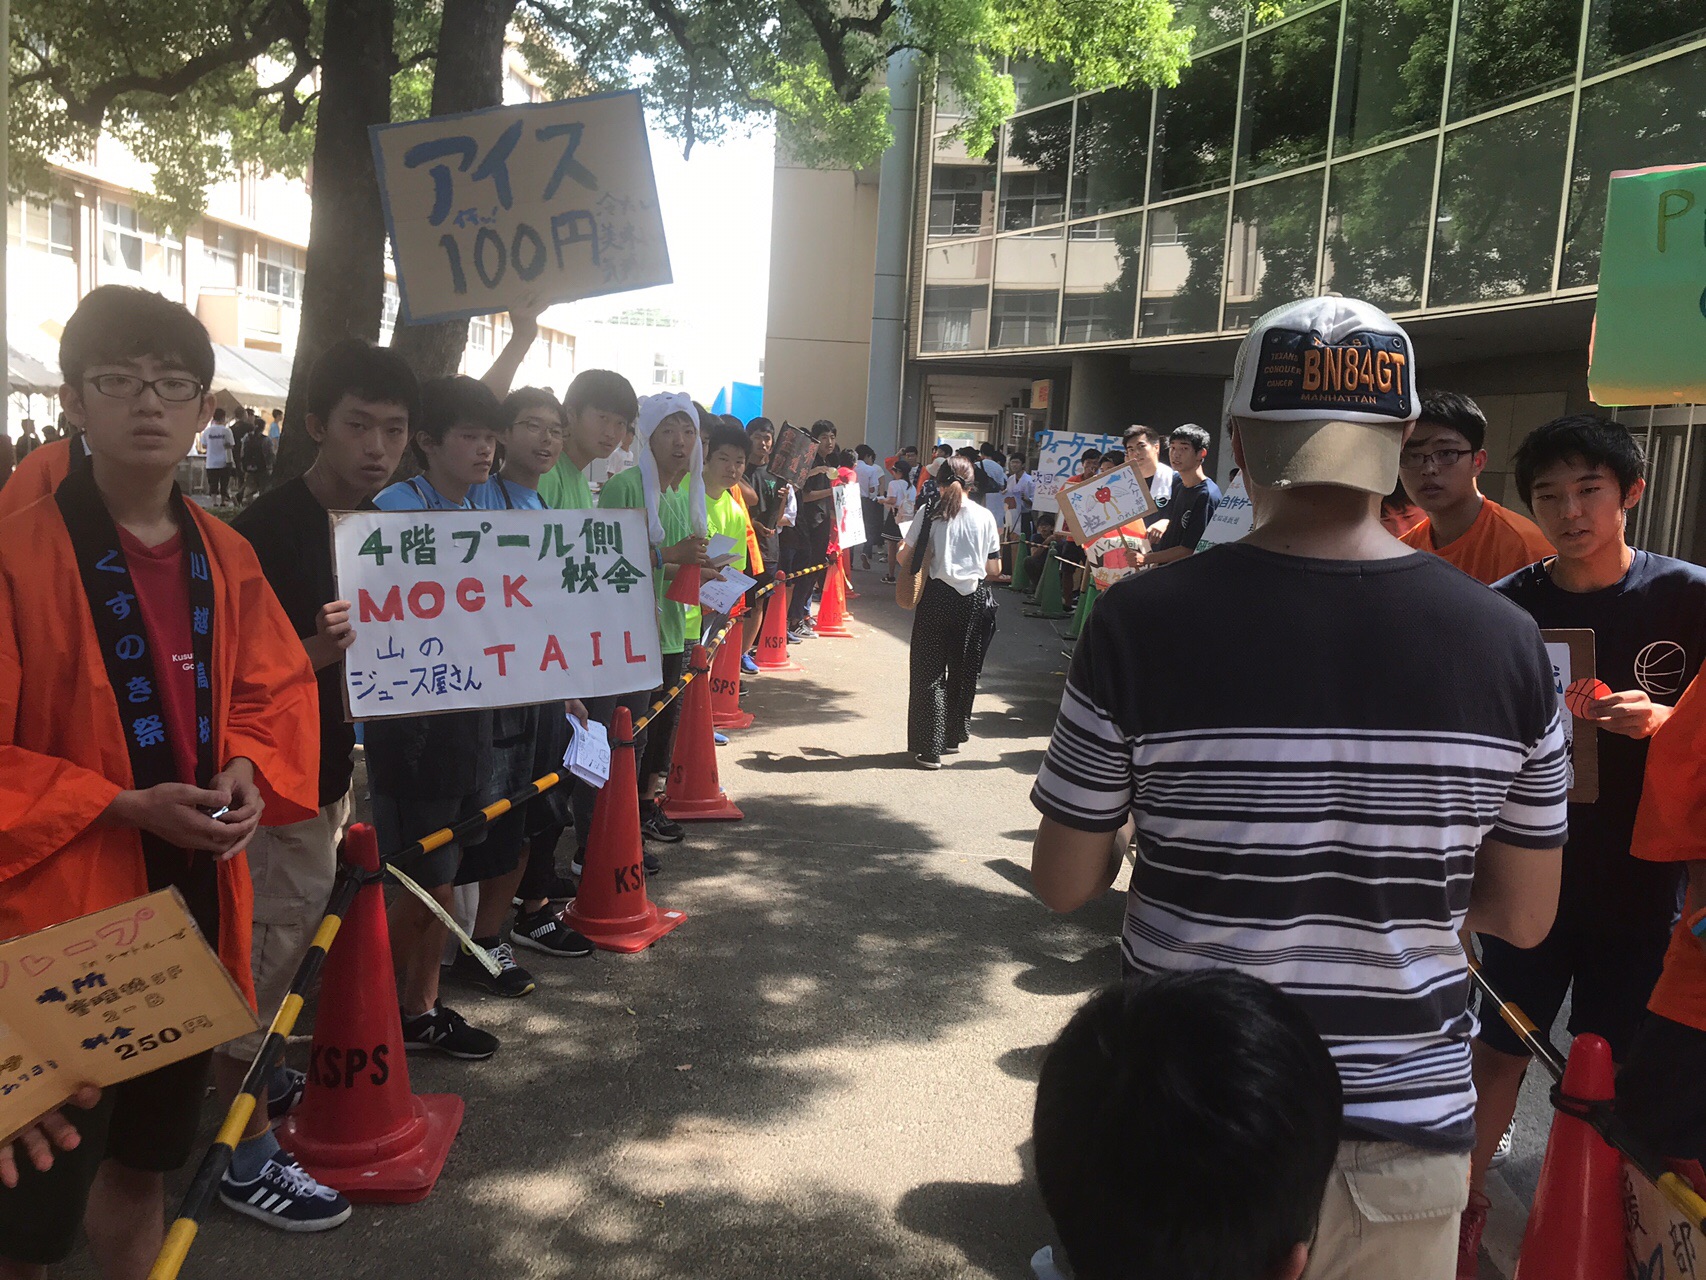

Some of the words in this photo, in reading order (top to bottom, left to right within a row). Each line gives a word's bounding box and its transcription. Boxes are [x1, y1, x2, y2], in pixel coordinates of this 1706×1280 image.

[404, 119, 599, 227] アイス
[438, 209, 601, 295] 100円
[1264, 366, 1301, 375] CONQUER
[1271, 352, 1299, 362] TEXANS
[1302, 347, 1406, 396] BN84GT
[1267, 380, 1294, 388] CANCER
[1301, 394, 1377, 405] MANHATTAN
[358, 517, 625, 566] 4階プール側
[562, 556, 647, 594] 校舎
[358, 575, 533, 623] MOCK
[95, 550, 165, 748] くすのき祭
[377, 635, 443, 660] 山の
[483, 630, 647, 677] TAIL
[351, 663, 482, 701] ジュース屋さん
[614, 861, 643, 894] KS
[530, 921, 557, 940] PUMA
[114, 1014, 214, 1061] 250円
